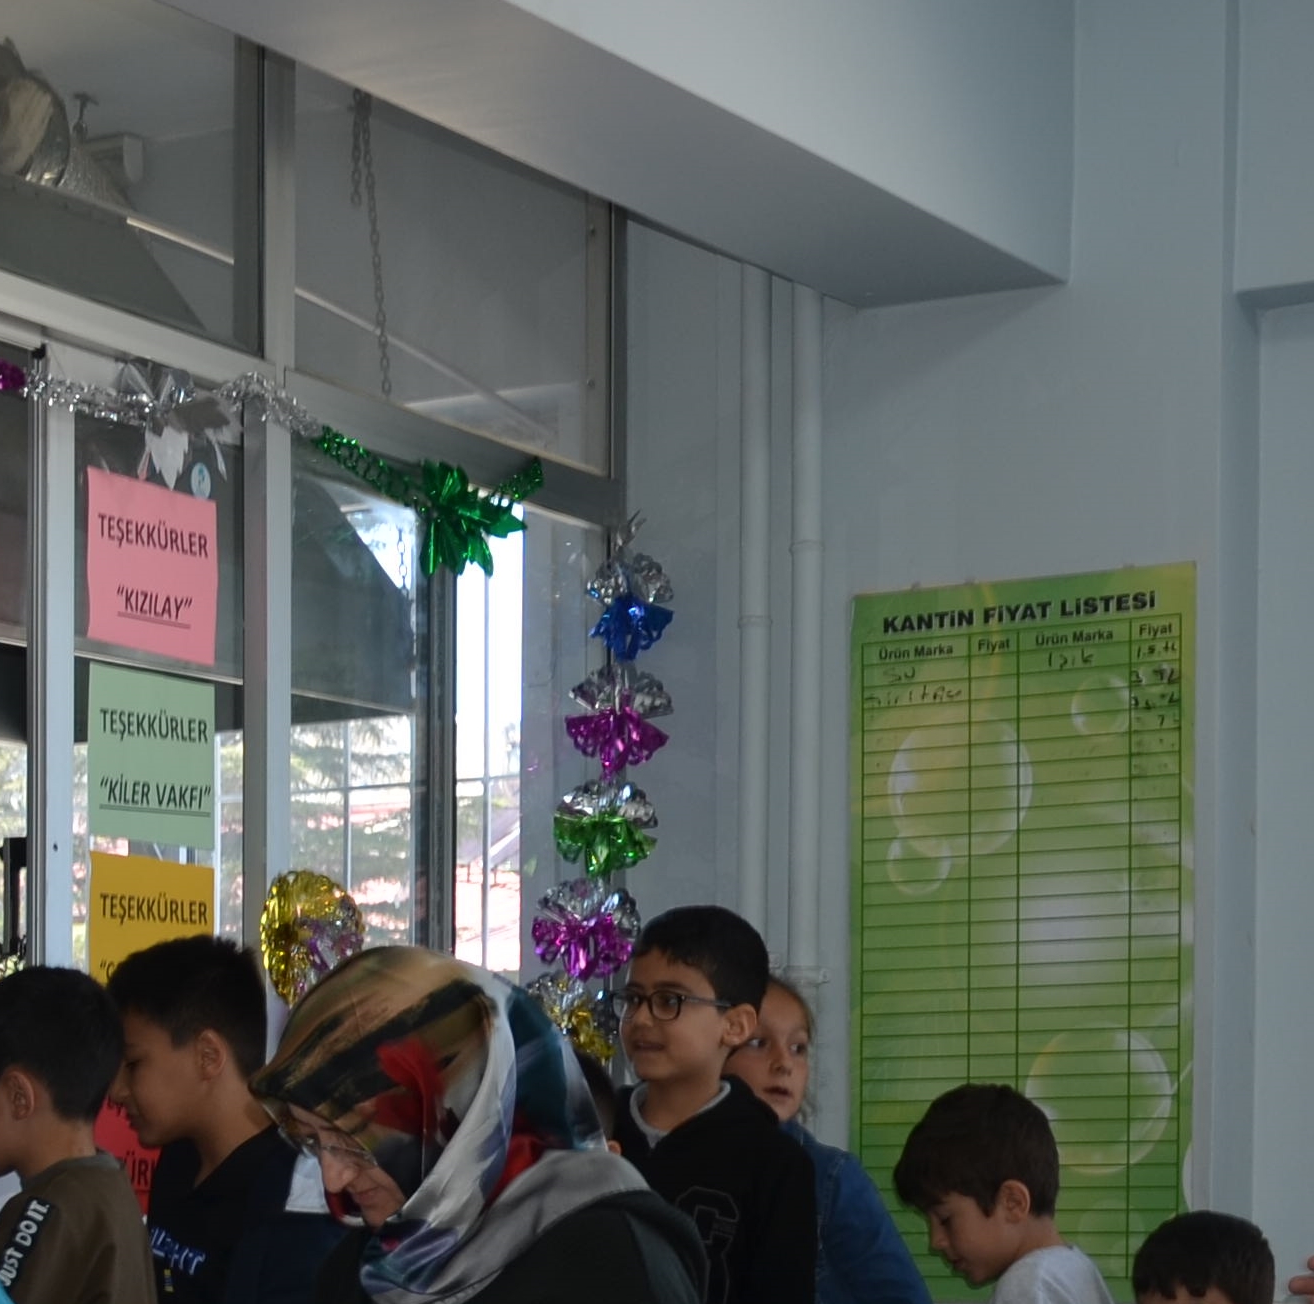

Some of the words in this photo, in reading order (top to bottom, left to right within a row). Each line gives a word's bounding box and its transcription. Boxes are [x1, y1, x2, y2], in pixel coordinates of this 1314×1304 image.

[97, 512, 209, 559] TEŞEKKÜRLER
[116, 585, 194, 623] “KIZILAY”
[977, 637, 1011, 653] Fiyat
[1035, 631, 1069, 647] Ürün
[1073, 628, 1115, 644] Marka
[1138, 622, 1173, 638] Fiyat
[878, 645, 911, 662] Ürün
[913, 643, 955, 658] Marka
[99, 706, 209, 744] TEŞEKKÜRLER
[99, 771, 151, 807] “KİLER
[155, 782, 212, 812] VAKFI”
[99, 892, 208, 926] TEŞEKKÜRLER
[14, 1219, 39, 1248] DO
